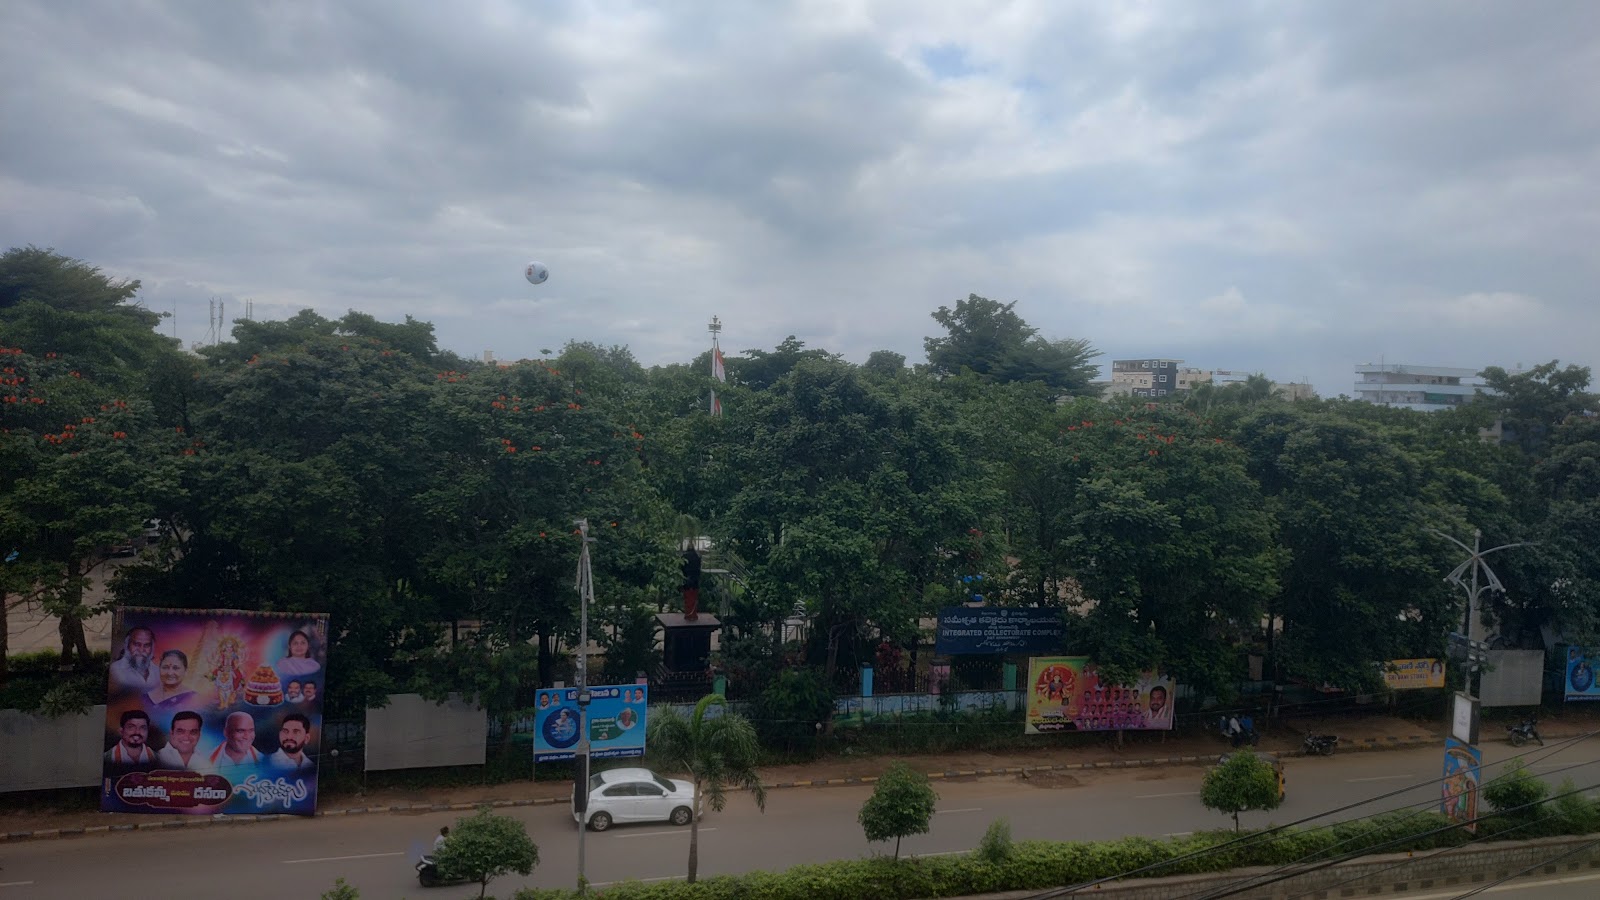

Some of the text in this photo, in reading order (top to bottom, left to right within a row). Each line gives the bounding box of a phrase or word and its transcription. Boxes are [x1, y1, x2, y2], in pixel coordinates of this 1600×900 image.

[942, 629, 982, 637] INTEGRATED
[122, 785, 171, 802] బతుకమ్మ
[193, 786, 227, 799] దసరా
[233, 774, 307, 808] శుభాకాంక్షలు
